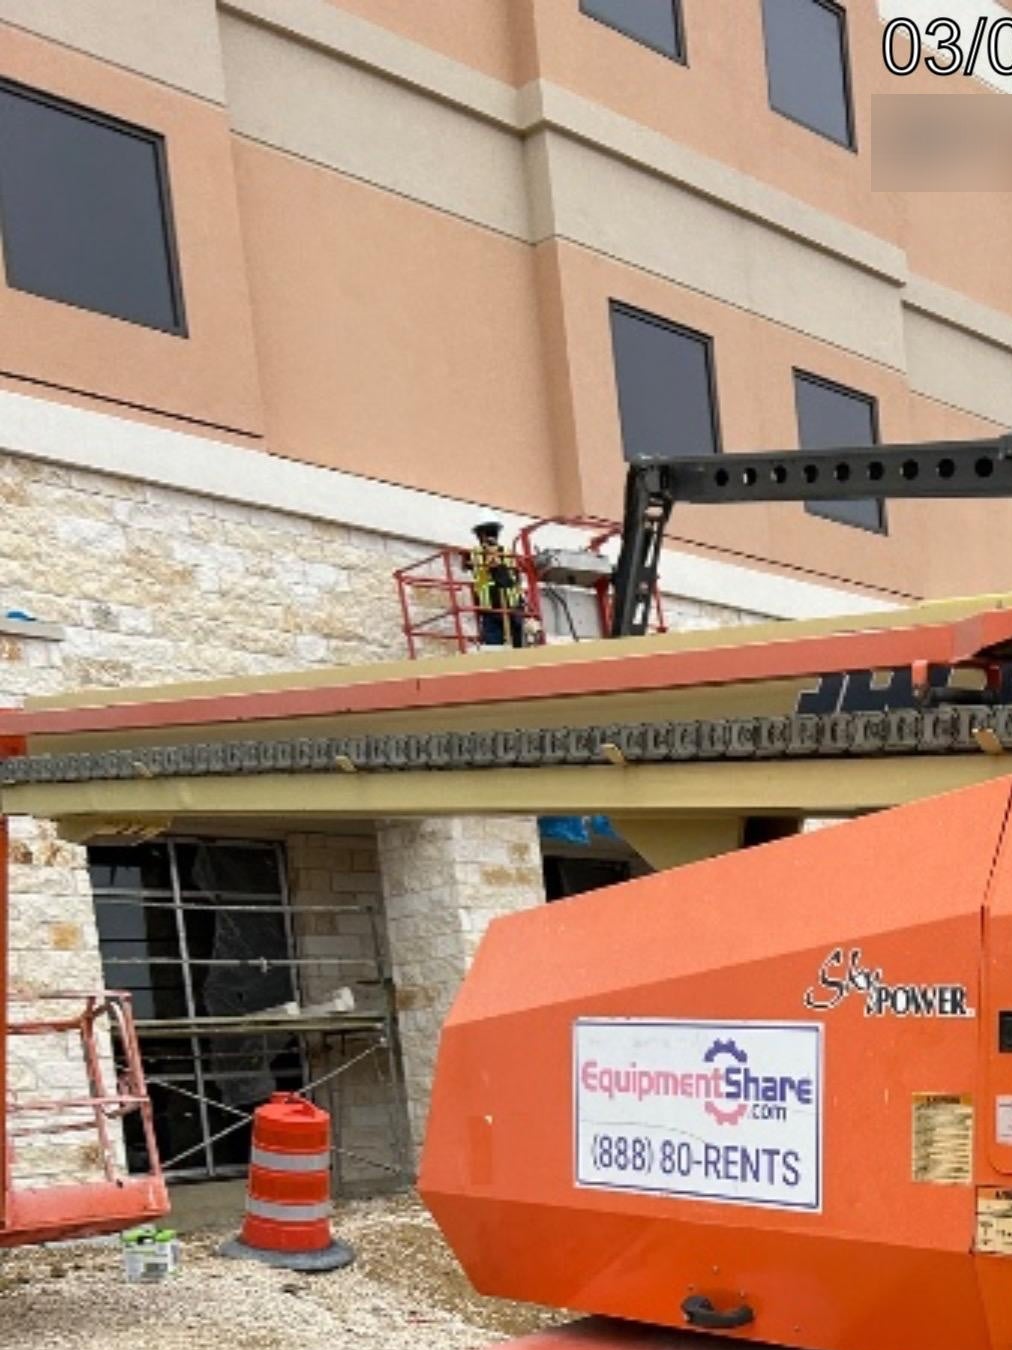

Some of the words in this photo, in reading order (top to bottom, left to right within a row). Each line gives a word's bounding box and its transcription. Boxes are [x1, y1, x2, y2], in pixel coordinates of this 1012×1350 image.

[581, 1059, 813, 1105] EquipmentShare
[747, 1104, 787, 1122] .com
[592, 1134, 654, 1173] (888)
[659, 1139, 801, 1187] 80-RENTS
